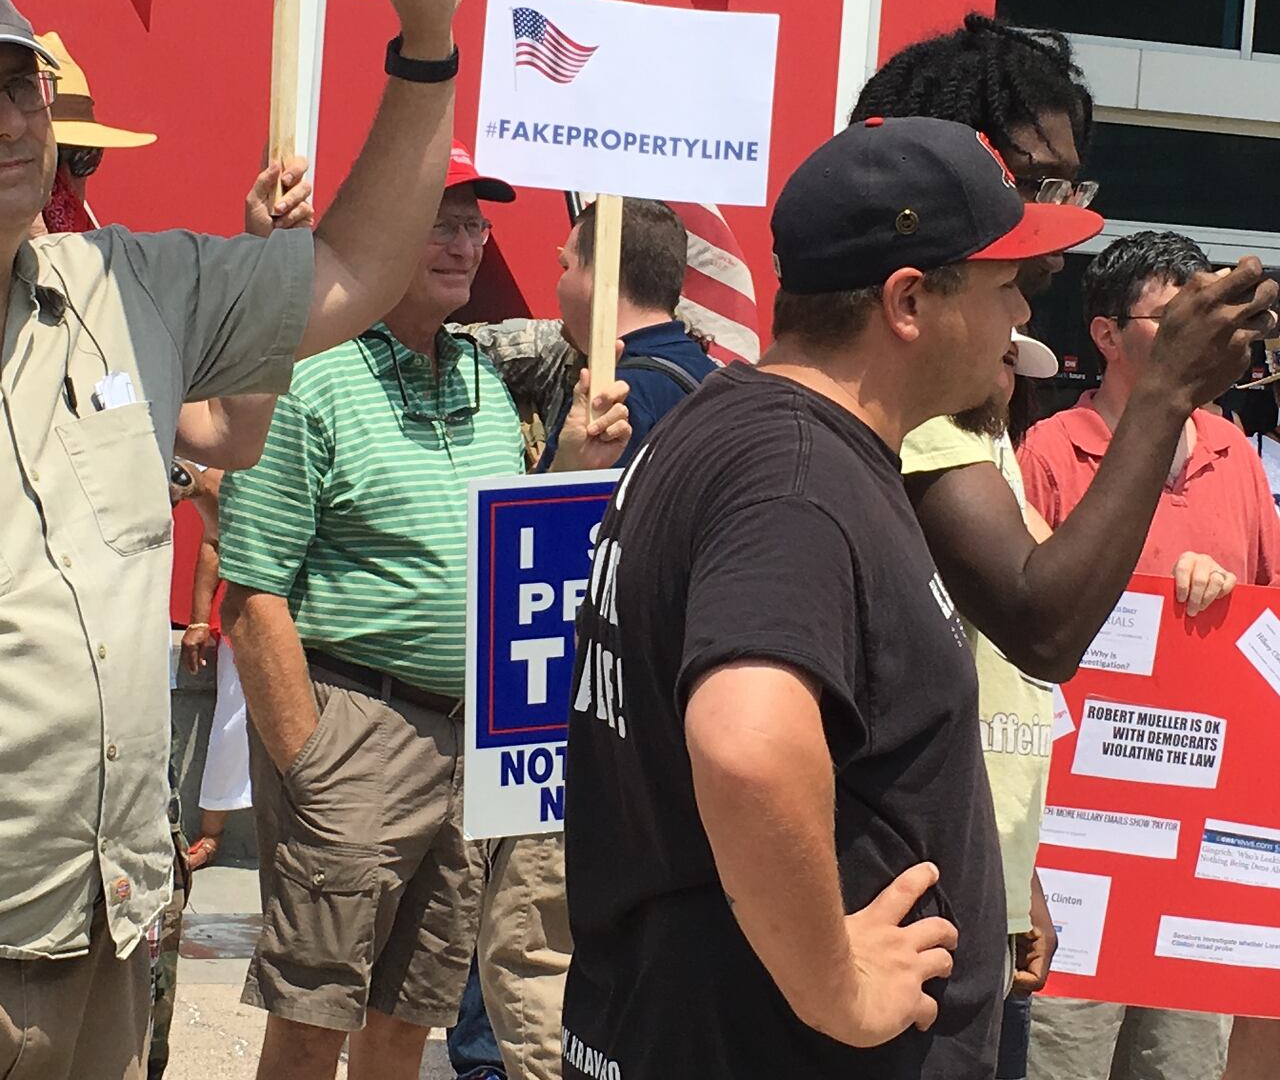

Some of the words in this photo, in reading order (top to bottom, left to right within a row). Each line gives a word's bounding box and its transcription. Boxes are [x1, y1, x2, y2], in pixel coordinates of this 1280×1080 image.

[485, 119, 759, 162] #FAKEPROPERTYLINE
[519, 527, 534, 569] I
[1087, 705, 1135, 724] ROBERT
[1136, 712, 1187, 731] MUELLER
[1190, 720, 1202, 733] IS
[1205, 720, 1220, 735] OK
[1113, 726, 1145, 743] WITH
[1147, 730, 1218, 751] DEMOCRATS
[1102, 741, 1164, 763] VIOLATING
[1167, 750, 1187, 766] THE
[1190, 752, 1216, 768] LAW
[1056, 808, 1075, 819] MORE
[1076, 810, 1103, 822] HILLARY
[1051, 892, 1082, 906] Clinton
